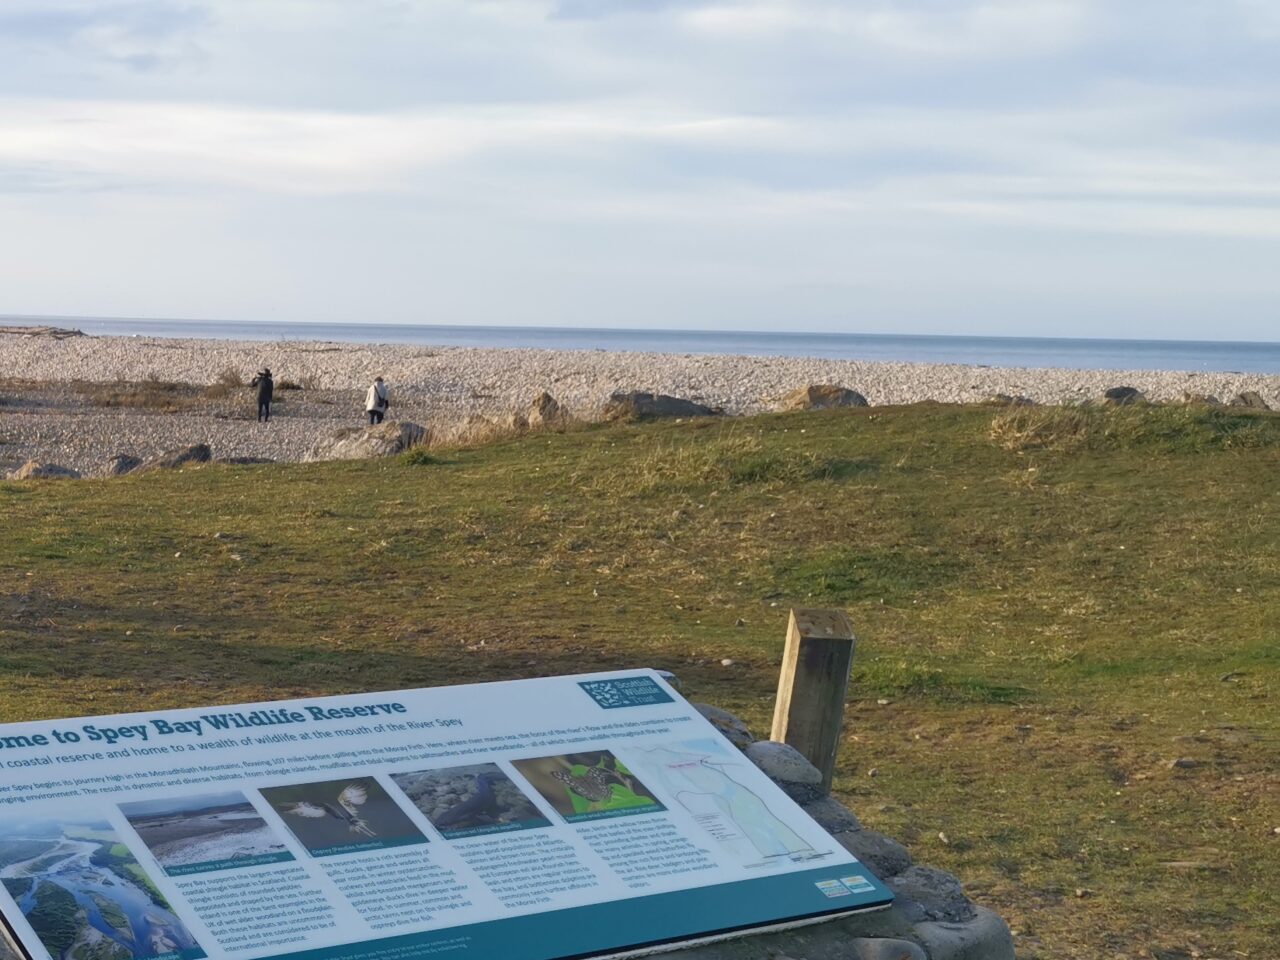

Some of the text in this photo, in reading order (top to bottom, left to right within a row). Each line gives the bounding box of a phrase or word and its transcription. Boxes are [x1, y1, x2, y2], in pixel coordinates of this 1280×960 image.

[614, 679, 654, 688] Scottish
[622, 687, 660, 696] Wildlife
[52, 730, 80, 744] to
[83, 725, 148, 744] Spey
[150, 720, 202, 736] Bay
[200, 709, 306, 729] Wildlife
[304, 703, 406, 720] Reserve
[7, 756, 53, 768] coastal
[56, 753, 104, 763] reserve
[106, 748, 130, 758] and
[130, 747, 169, 756] home
[196, 739, 239, 749] wealth
[240, 736, 253, 746] of
[255, 733, 297, 744] wildlife
[312, 730, 333, 739] the
[334, 726, 372, 736] mouth
[374, 724, 386, 732] of
[386, 723, 407, 731] the
[406, 721, 434, 729] River
[435, 719, 463, 727] Spey
[73, 778, 105, 786] journey
[148, 767, 199, 776] Monadhliath
[132, 781, 165, 790] dynamic
[272, 867, 304, 875] vegetated
[248, 887, 276, 895] rounded
[194, 903, 227, 912] deposited
[240, 897, 265, 905] shaped
[278, 900, 308, 908] examples
[255, 911, 287, 920] woodland
